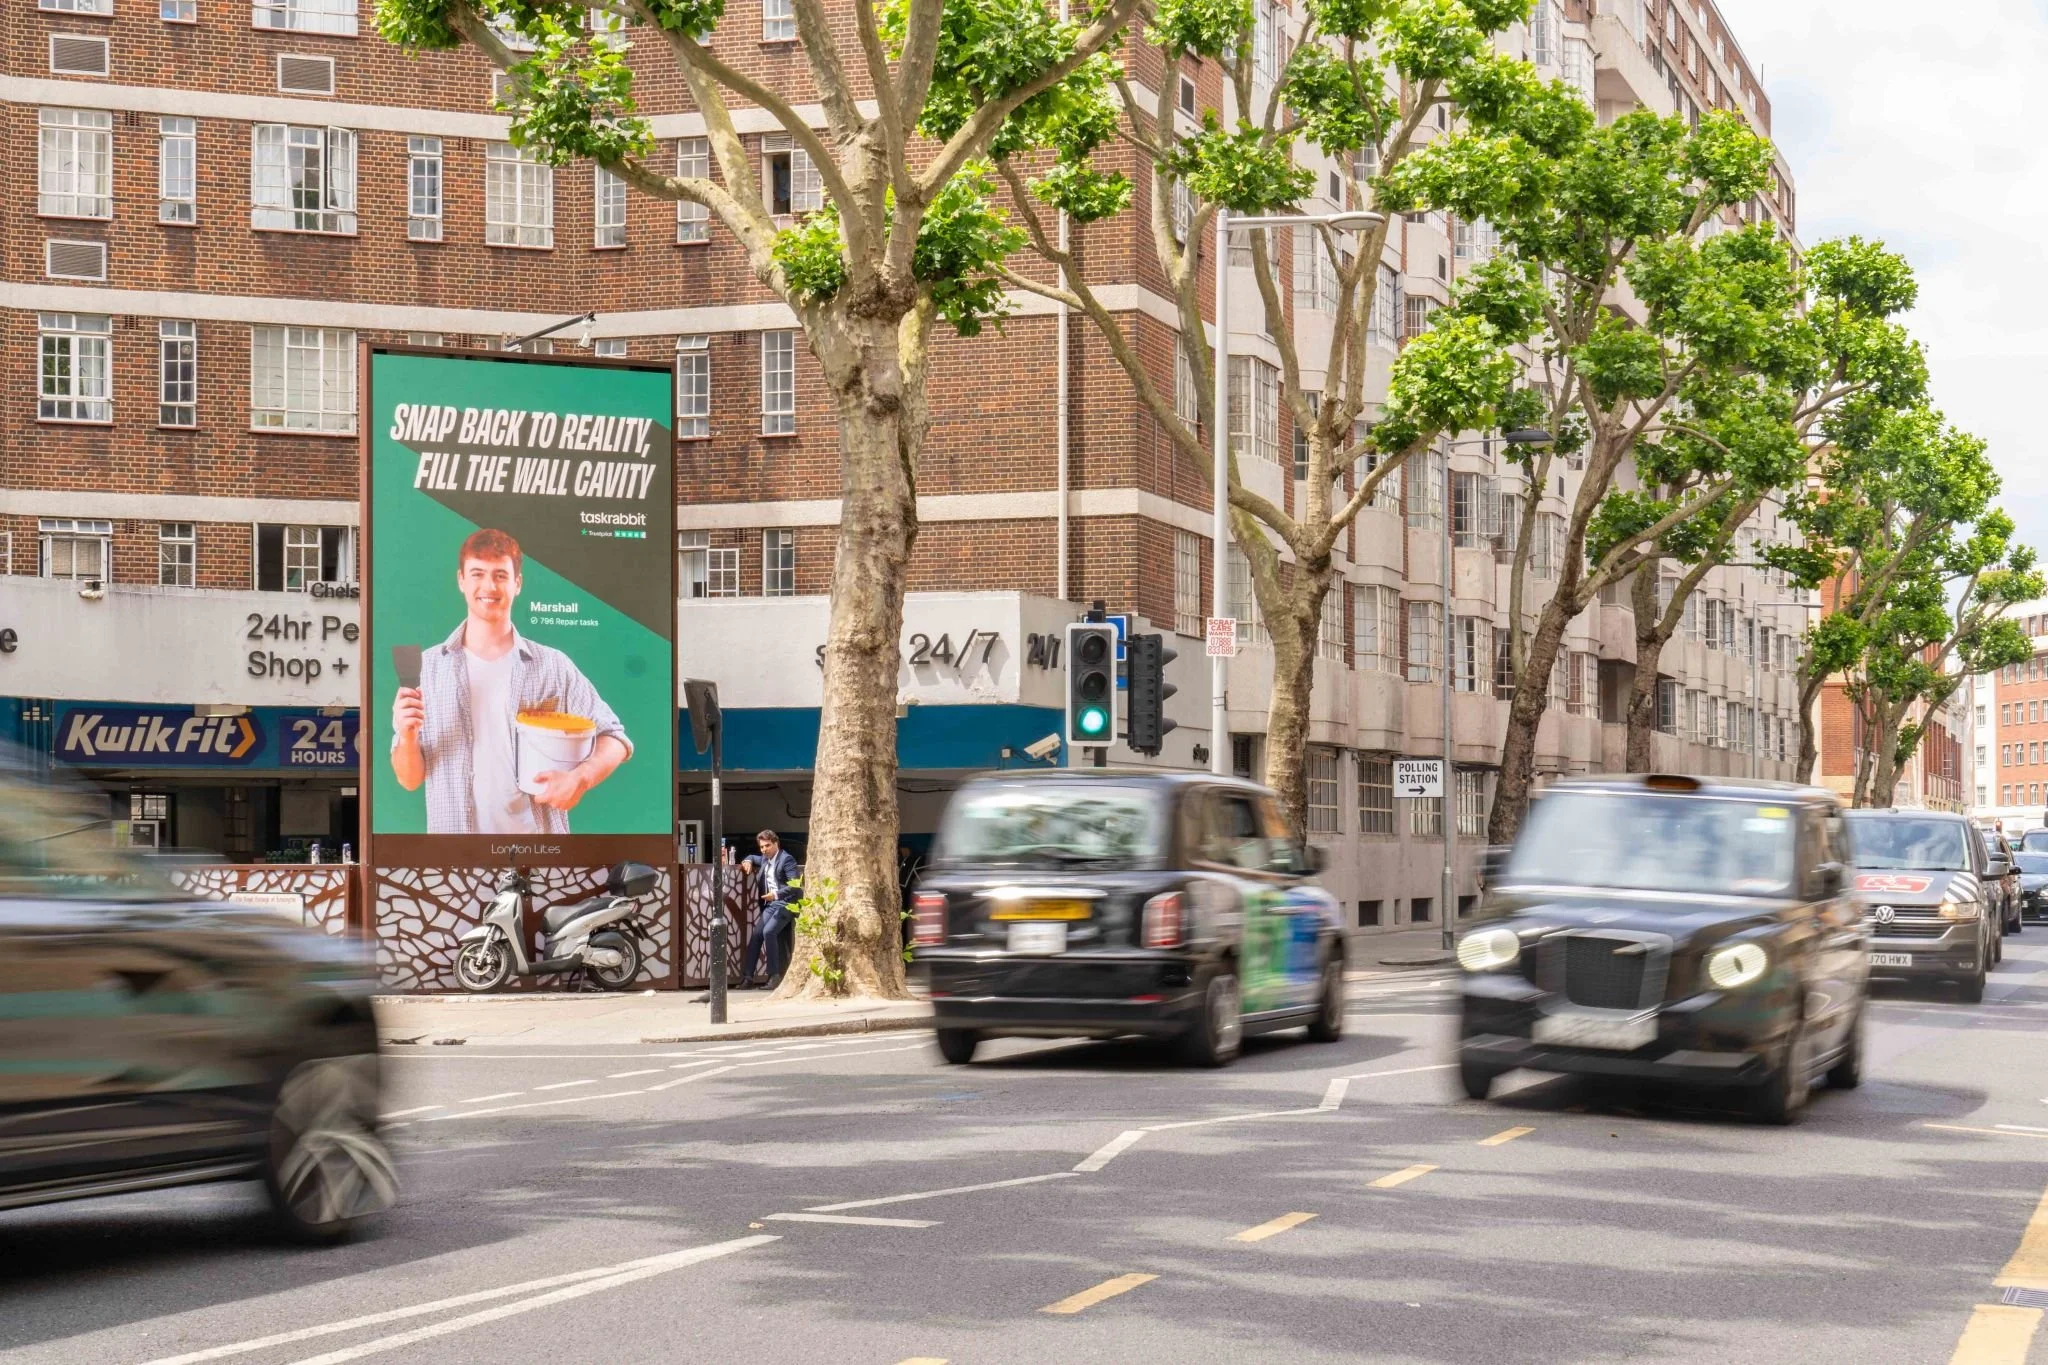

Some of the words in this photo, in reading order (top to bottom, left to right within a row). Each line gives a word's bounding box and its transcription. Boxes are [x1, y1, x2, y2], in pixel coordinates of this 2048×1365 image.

[390, 403, 457, 442] SNAP
[458, 407, 527, 447] BACK
[527, 411, 558, 449] TO
[559, 413, 653, 458] REALITY,
[413, 452, 460, 490] FILL
[464, 454, 511, 493] THE
[512, 457, 570, 496] WALL
[574, 460, 657, 499] CAVITY
[580, 511, 646, 526] taskrabbit
[311, 582, 359, 599] Chels
[530, 601, 578, 613] Marshall
[247, 613, 312, 641] 24hr
[322, 615, 359, 642] Pe
[555, 617, 578, 628] Repair
[579, 619, 599, 627] tasks
[909, 628, 1000, 668] 24/7
[248, 651, 322, 683] Shop
[291, 719, 346, 749] 24
[291, 751, 346, 764] HOURS
[1398, 763, 1438, 772] POLLING
[1399, 774, 1438, 783] STATION
[533, 844, 561, 855] Lites
[1867, 954, 1887, 964] J70
